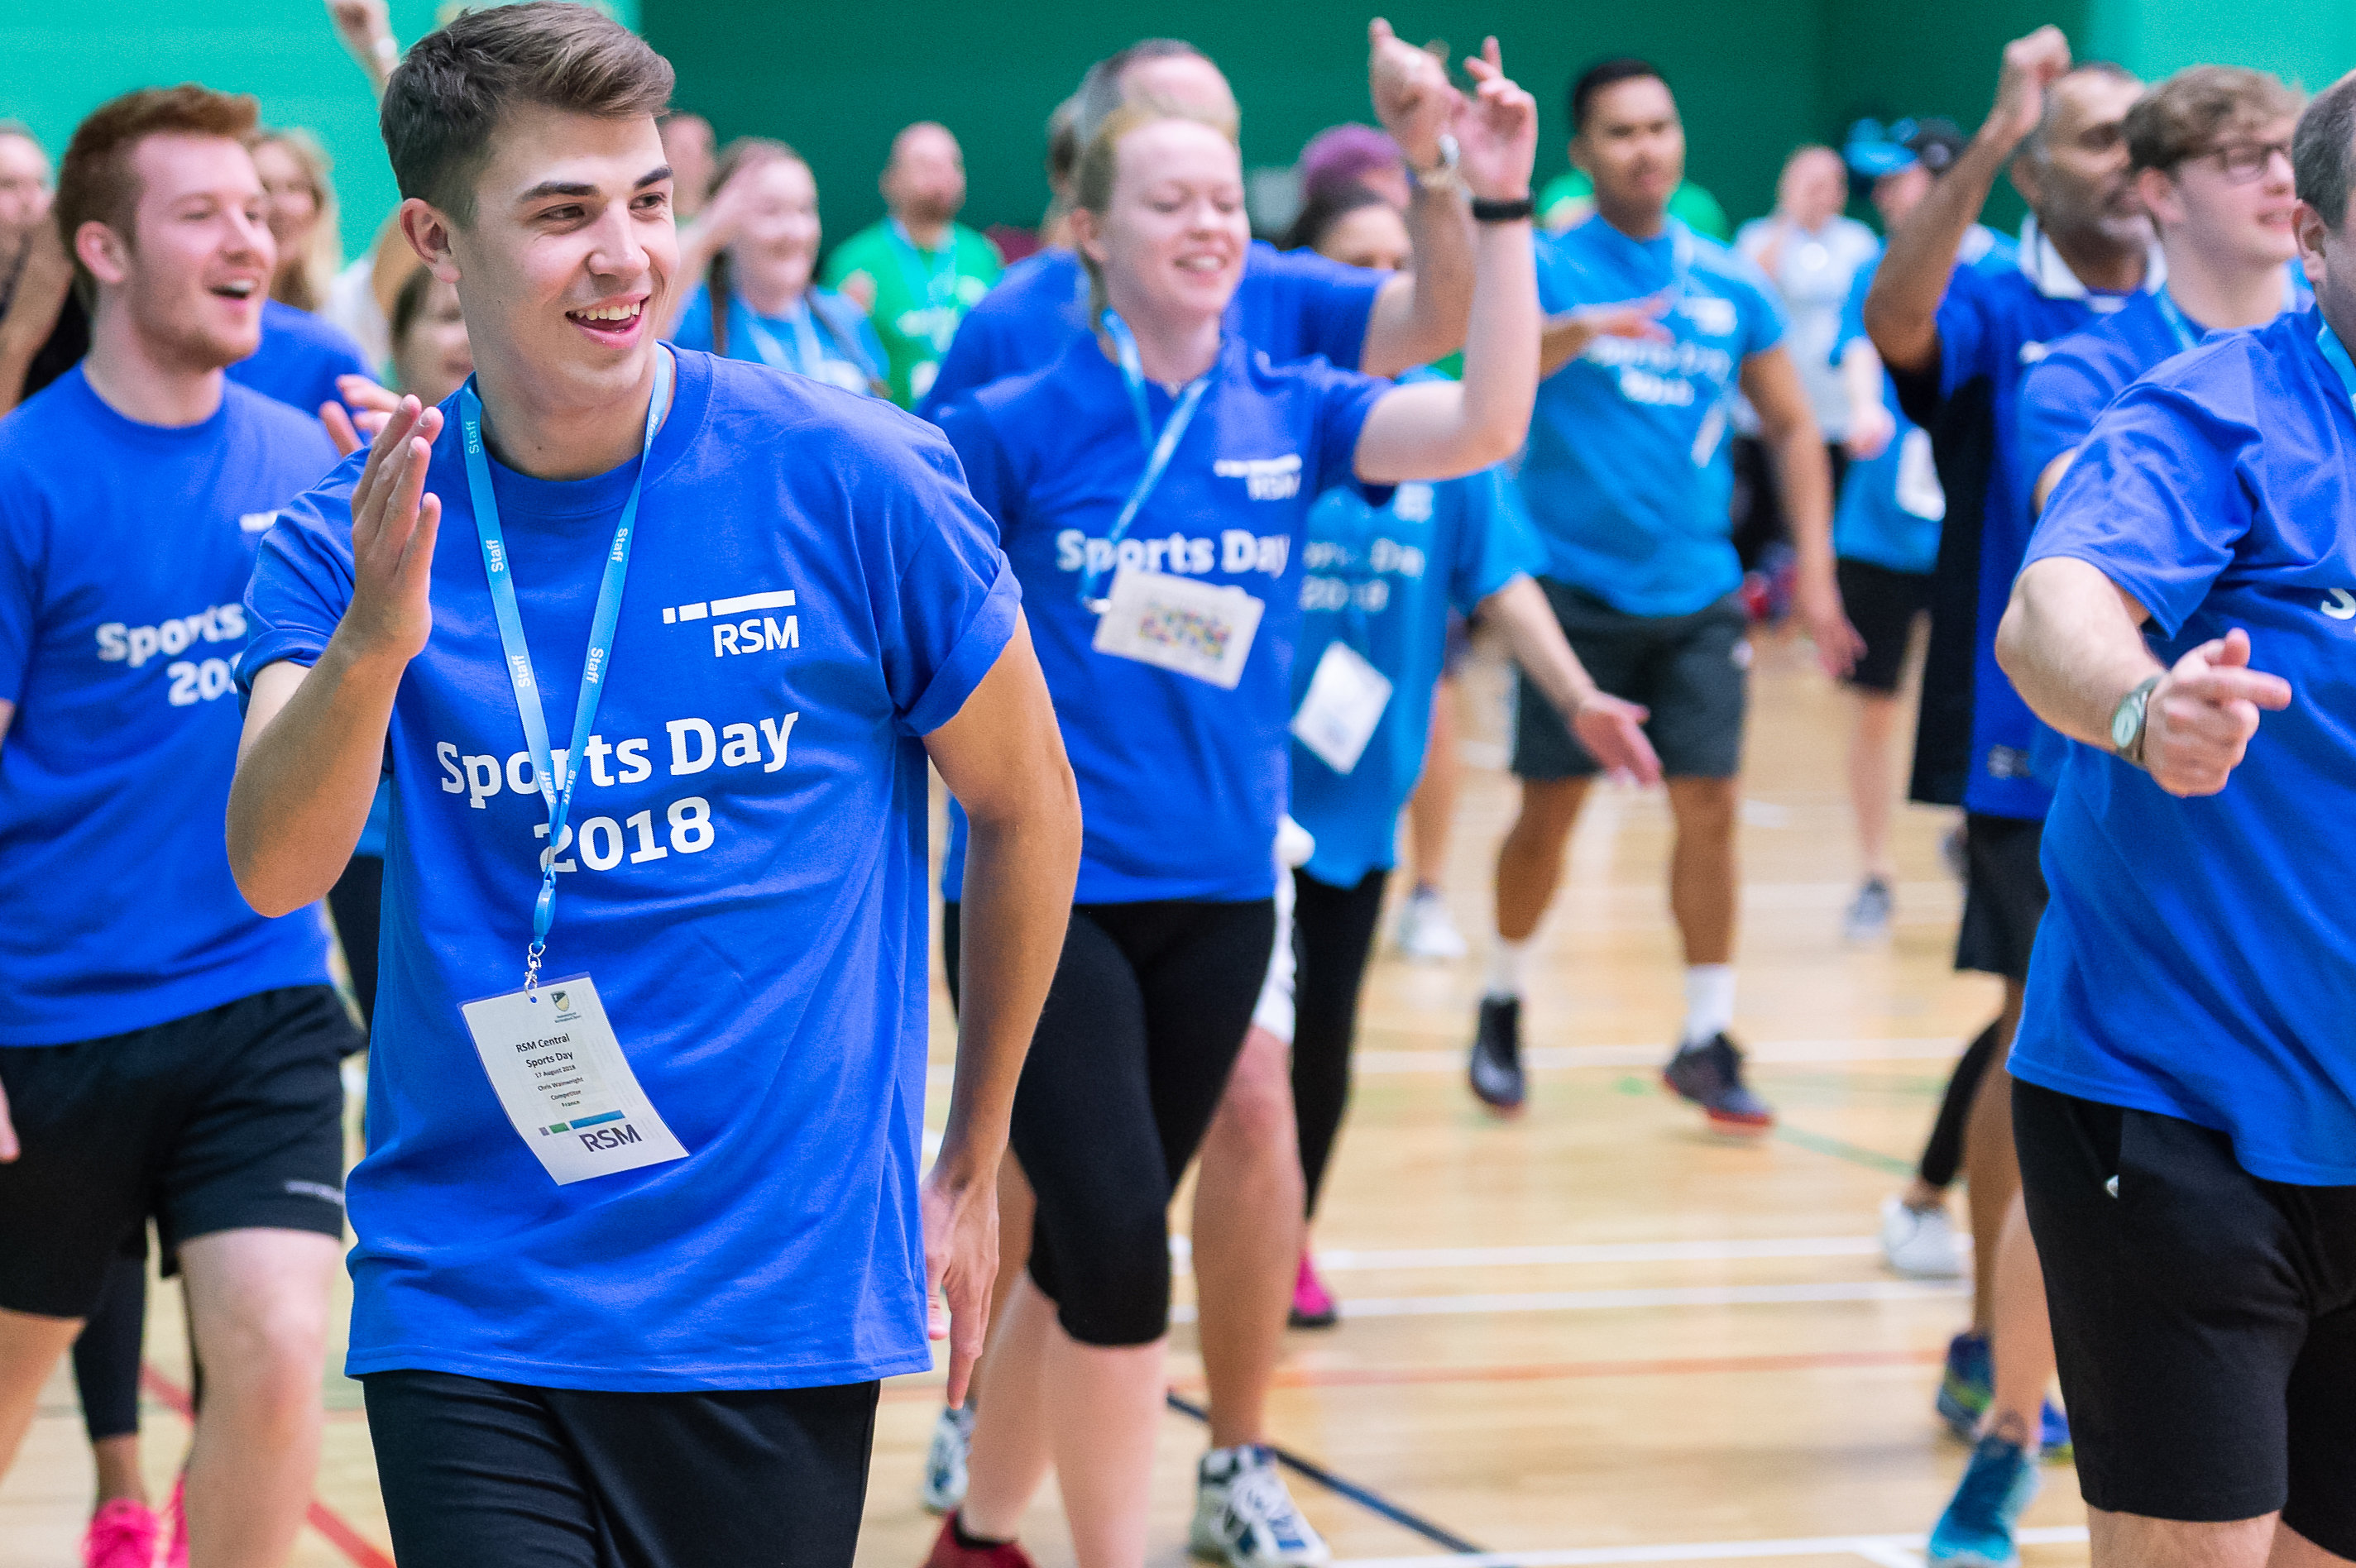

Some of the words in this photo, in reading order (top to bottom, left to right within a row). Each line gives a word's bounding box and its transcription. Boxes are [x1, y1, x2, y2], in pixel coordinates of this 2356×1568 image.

[466, 420, 480, 454] Staff
[486, 539, 504, 572] Staff
[611, 527, 629, 562] Staff
[1056, 528, 1215, 575] Sports
[1221, 528, 1291, 579] Day
[96, 602, 247, 668] Sports
[712, 614, 799, 657] RSM
[511, 654, 531, 688] Staff
[586, 647, 604, 684] Staff
[437, 734, 653, 810] Sports
[665, 711, 799, 773] Day
[539, 770, 557, 804] Staff
[563, 769, 577, 806] Staff
[534, 796, 716, 872] 2018
[515, 1040, 538, 1053] RSM
[538, 1032, 570, 1048] Central
[525, 1055, 555, 1068] Sports
[555, 1051, 574, 1061] Day
[543, 1068, 563, 1076] August
[578, 1124, 643, 1152] RSM
